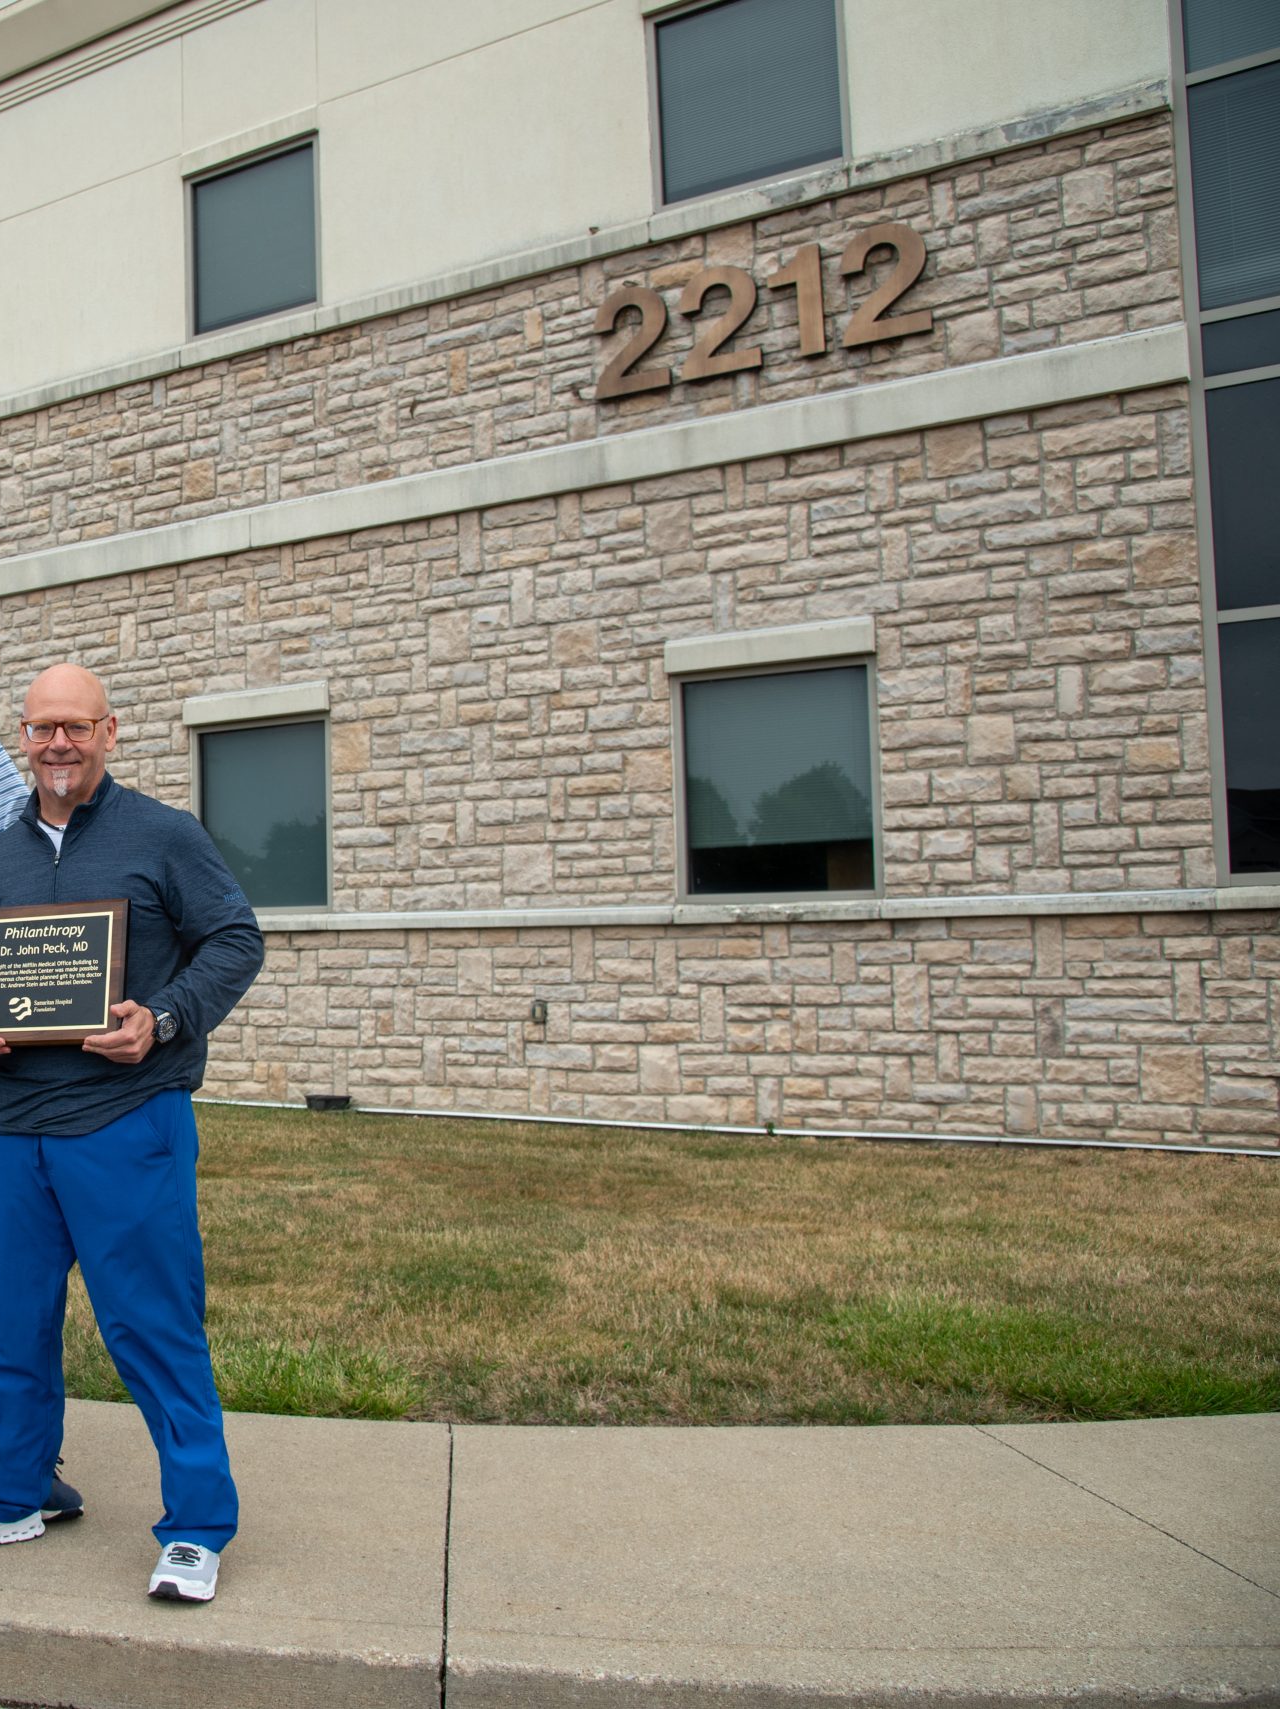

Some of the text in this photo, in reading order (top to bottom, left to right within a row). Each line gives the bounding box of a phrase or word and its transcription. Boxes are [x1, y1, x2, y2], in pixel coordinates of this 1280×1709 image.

[594, 223, 933, 400] 2212
[5, 925, 85, 939] Philanthropy
[0, 941, 88, 956] Dr. John Peck, MD
